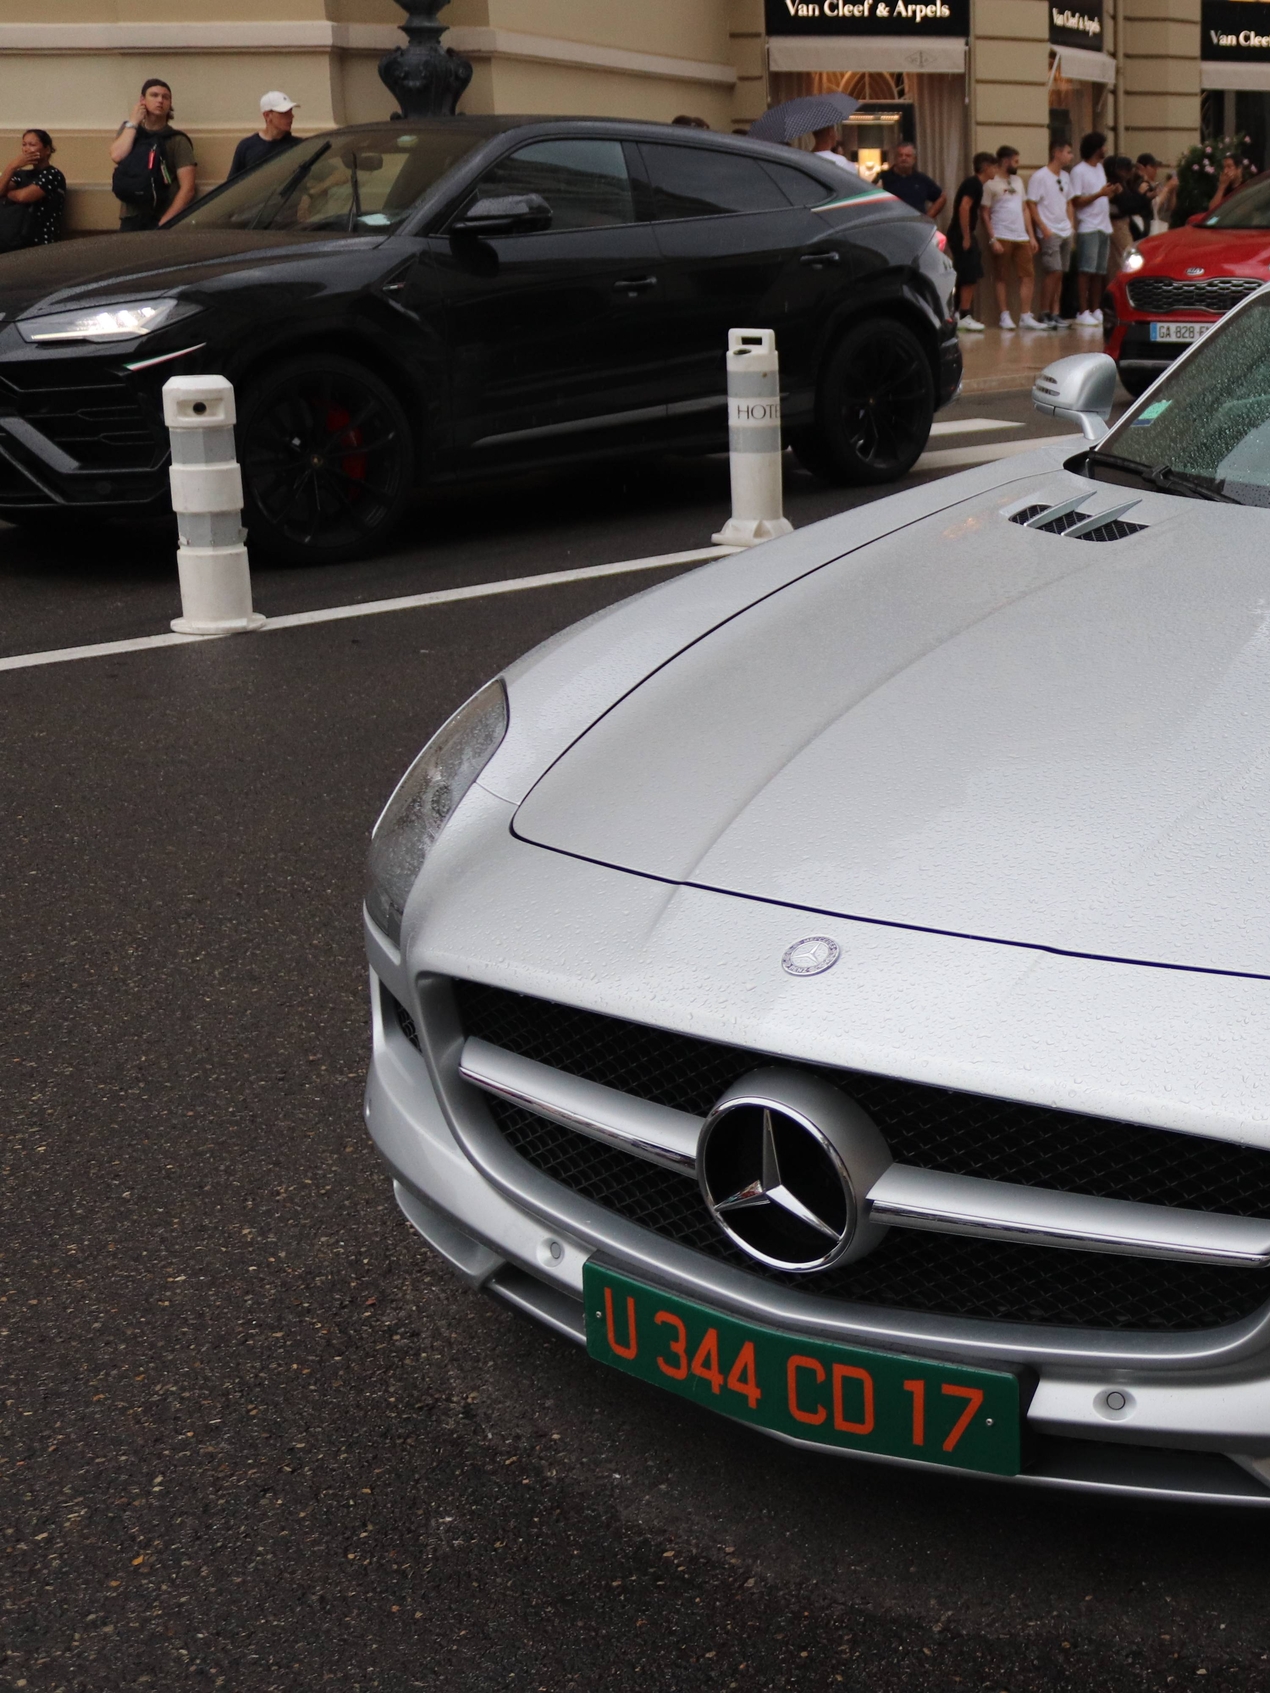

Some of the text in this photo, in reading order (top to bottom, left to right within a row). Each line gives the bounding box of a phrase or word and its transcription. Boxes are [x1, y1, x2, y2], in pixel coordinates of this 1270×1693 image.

[786, 0, 950, 23] Van Cleef & Arpels
[1210, 29, 1237, 47] Van
[604, 1287, 984, 1453] U 344 CD 17
